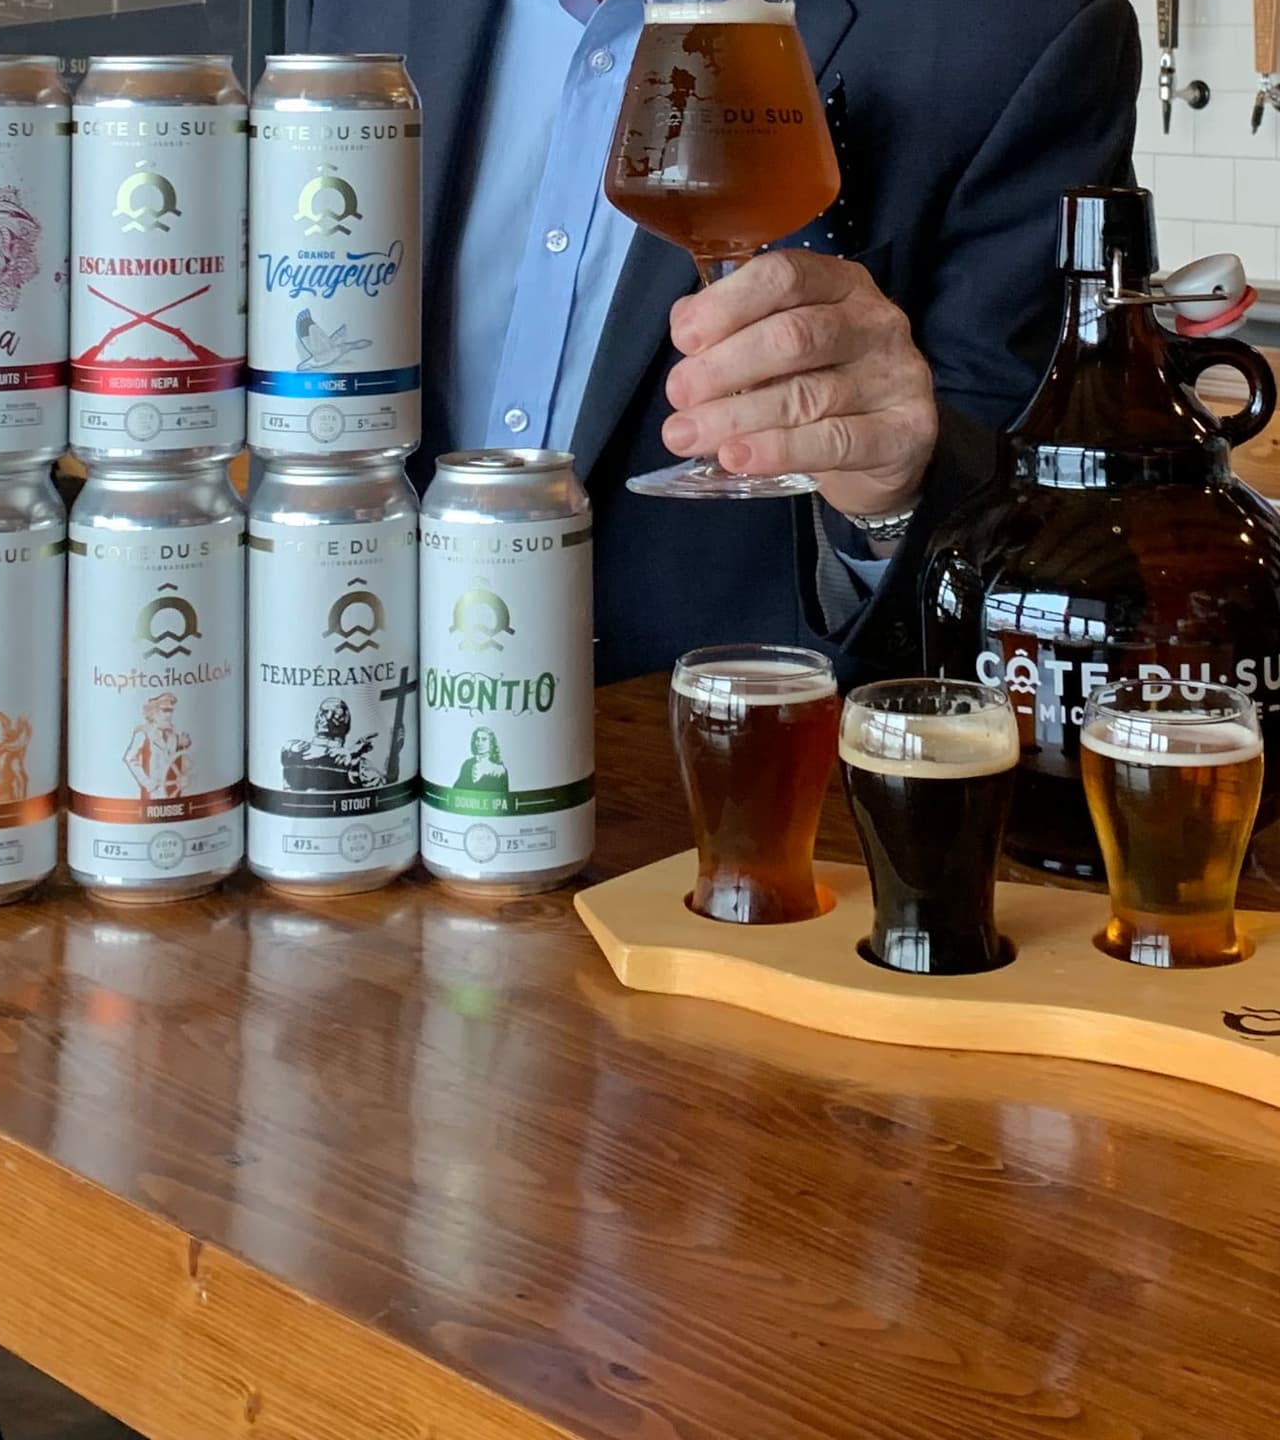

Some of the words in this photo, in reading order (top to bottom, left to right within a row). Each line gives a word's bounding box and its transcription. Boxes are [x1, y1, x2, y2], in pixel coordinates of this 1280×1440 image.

[723, 108, 755, 126] DU
[767, 108, 803, 126] SUD
[360, 125, 398, 140] SUD
[297, 249, 336, 261] GRANDE
[79, 253, 225, 279] ESCARMOUCHE
[258, 240, 405, 300] Voyageuse
[160, 543, 191, 559] DU
[349, 538, 380, 555] DU
[512, 536, 554, 553] SUD
[260, 661, 396, 688] TEMPÉRANCE
[975, 649, 1112, 700] CÔTE
[1138, 662, 1212, 702] DU
[146, 803, 185, 817] ROUSSE
[340, 796, 372, 811] STOUT
[491, 798, 508, 810] IPA
